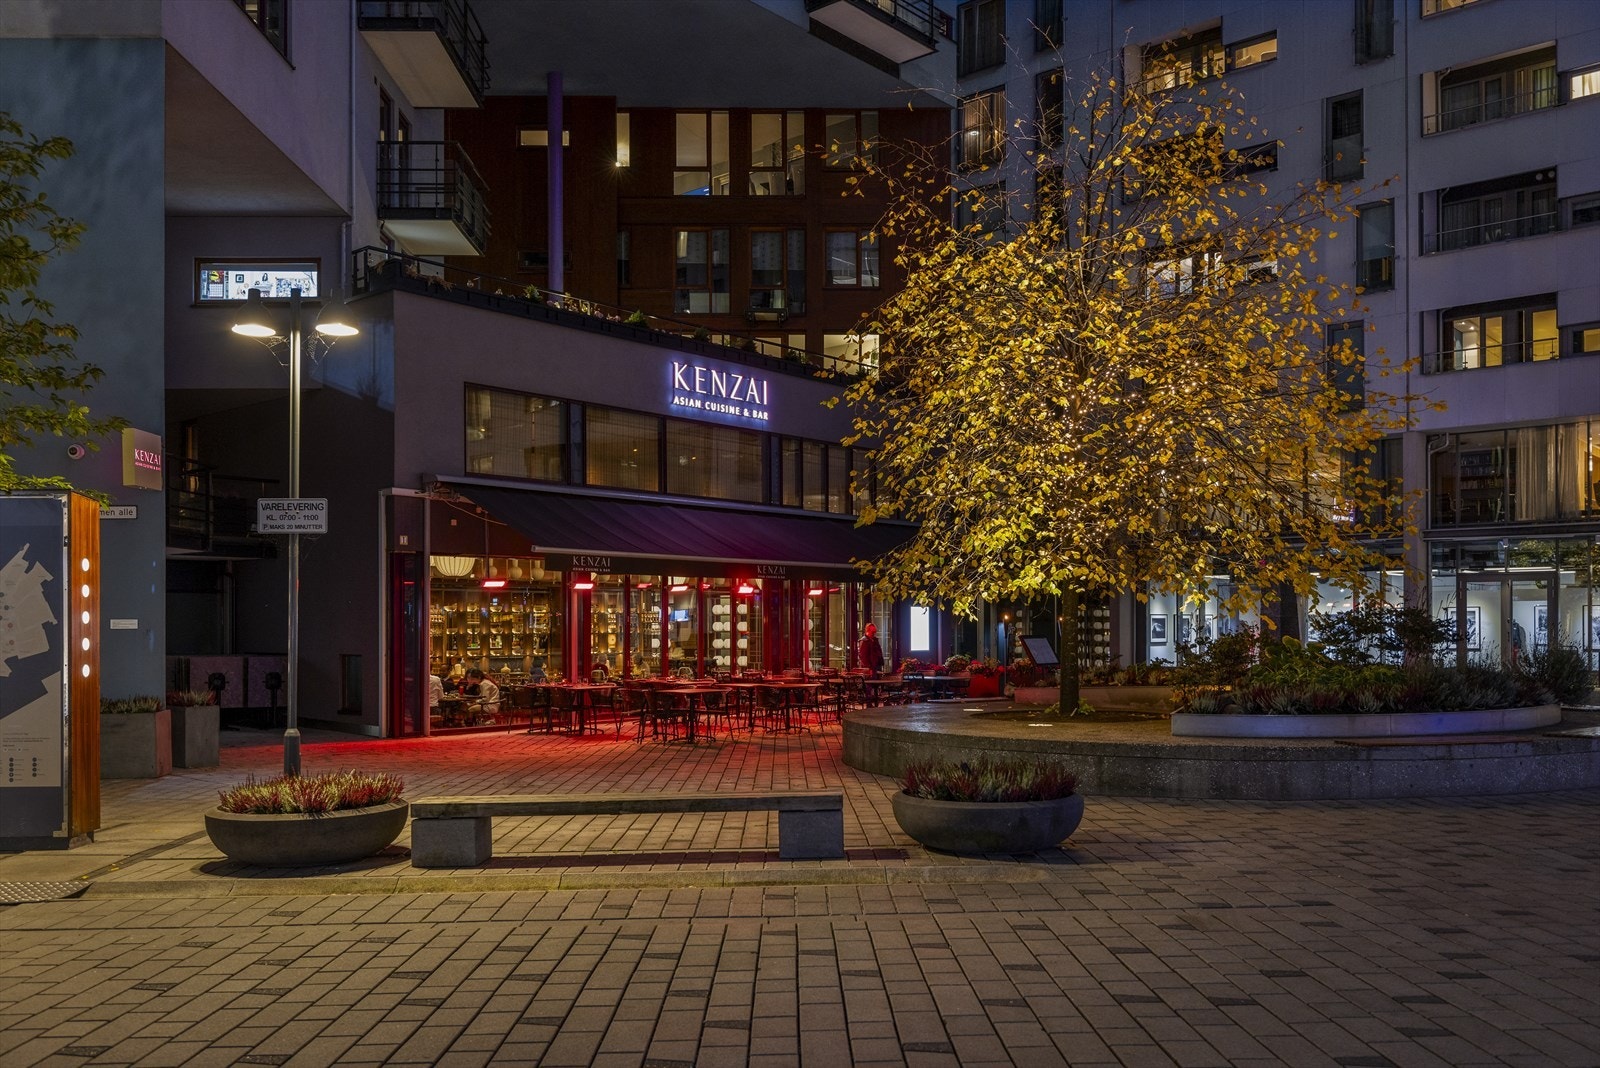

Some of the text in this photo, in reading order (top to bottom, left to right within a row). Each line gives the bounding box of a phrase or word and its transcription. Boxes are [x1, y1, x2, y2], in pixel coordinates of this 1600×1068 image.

[673, 361, 768, 405] KENZAI
[673, 396, 769, 420] ASIAN CUISINE & BAR
[134, 448, 161, 466] KENZAI
[261, 502, 325, 511] VARELEVERING
[572, 555, 611, 567] KENZAI
[757, 564, 786, 575] KENZAI
